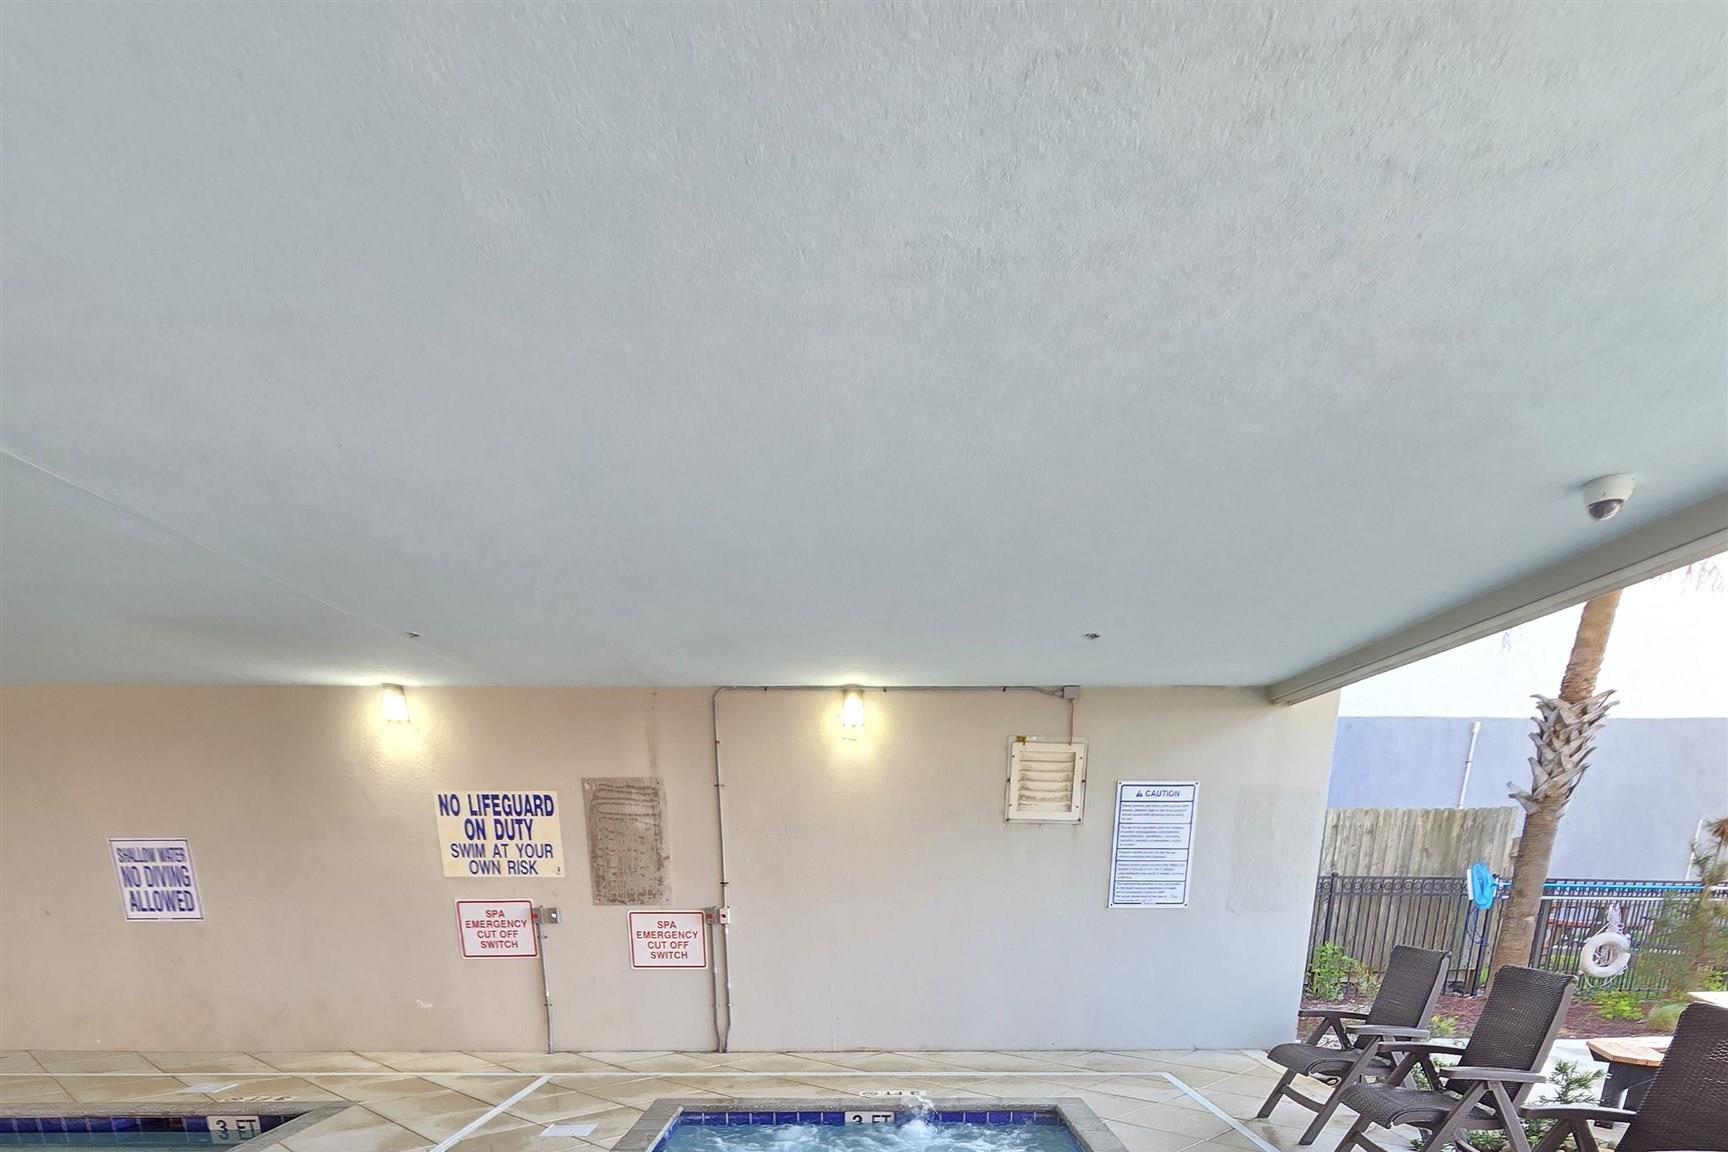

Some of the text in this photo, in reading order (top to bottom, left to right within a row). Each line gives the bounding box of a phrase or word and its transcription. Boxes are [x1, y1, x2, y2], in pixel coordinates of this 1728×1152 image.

[438, 794, 555, 817] NO LIFEGUARD
[464, 818, 534, 841] ON DUTY
[450, 843, 554, 858] SWIM AT YOUR
[469, 860, 502, 875] OWN
[507, 860, 539, 875] RISK
[120, 865, 192, 887] NO DIVING
[129, 890, 195, 912] ALLOWED
[485, 909, 505, 918] SPA
[465, 920, 527, 928] EMERGENCY
[657, 920, 677, 929] SPA
[477, 930, 519, 938] CUT OFF
[636, 930, 698, 939] EMERGENCY
[480, 940, 519, 949] SWITCH
[647, 941, 689, 949] CUT OFF
[650, 951, 688, 960] SWITCH
[852, 1114, 892, 1125] 3 FT
[216, 1119, 257, 1140] 3 FT
